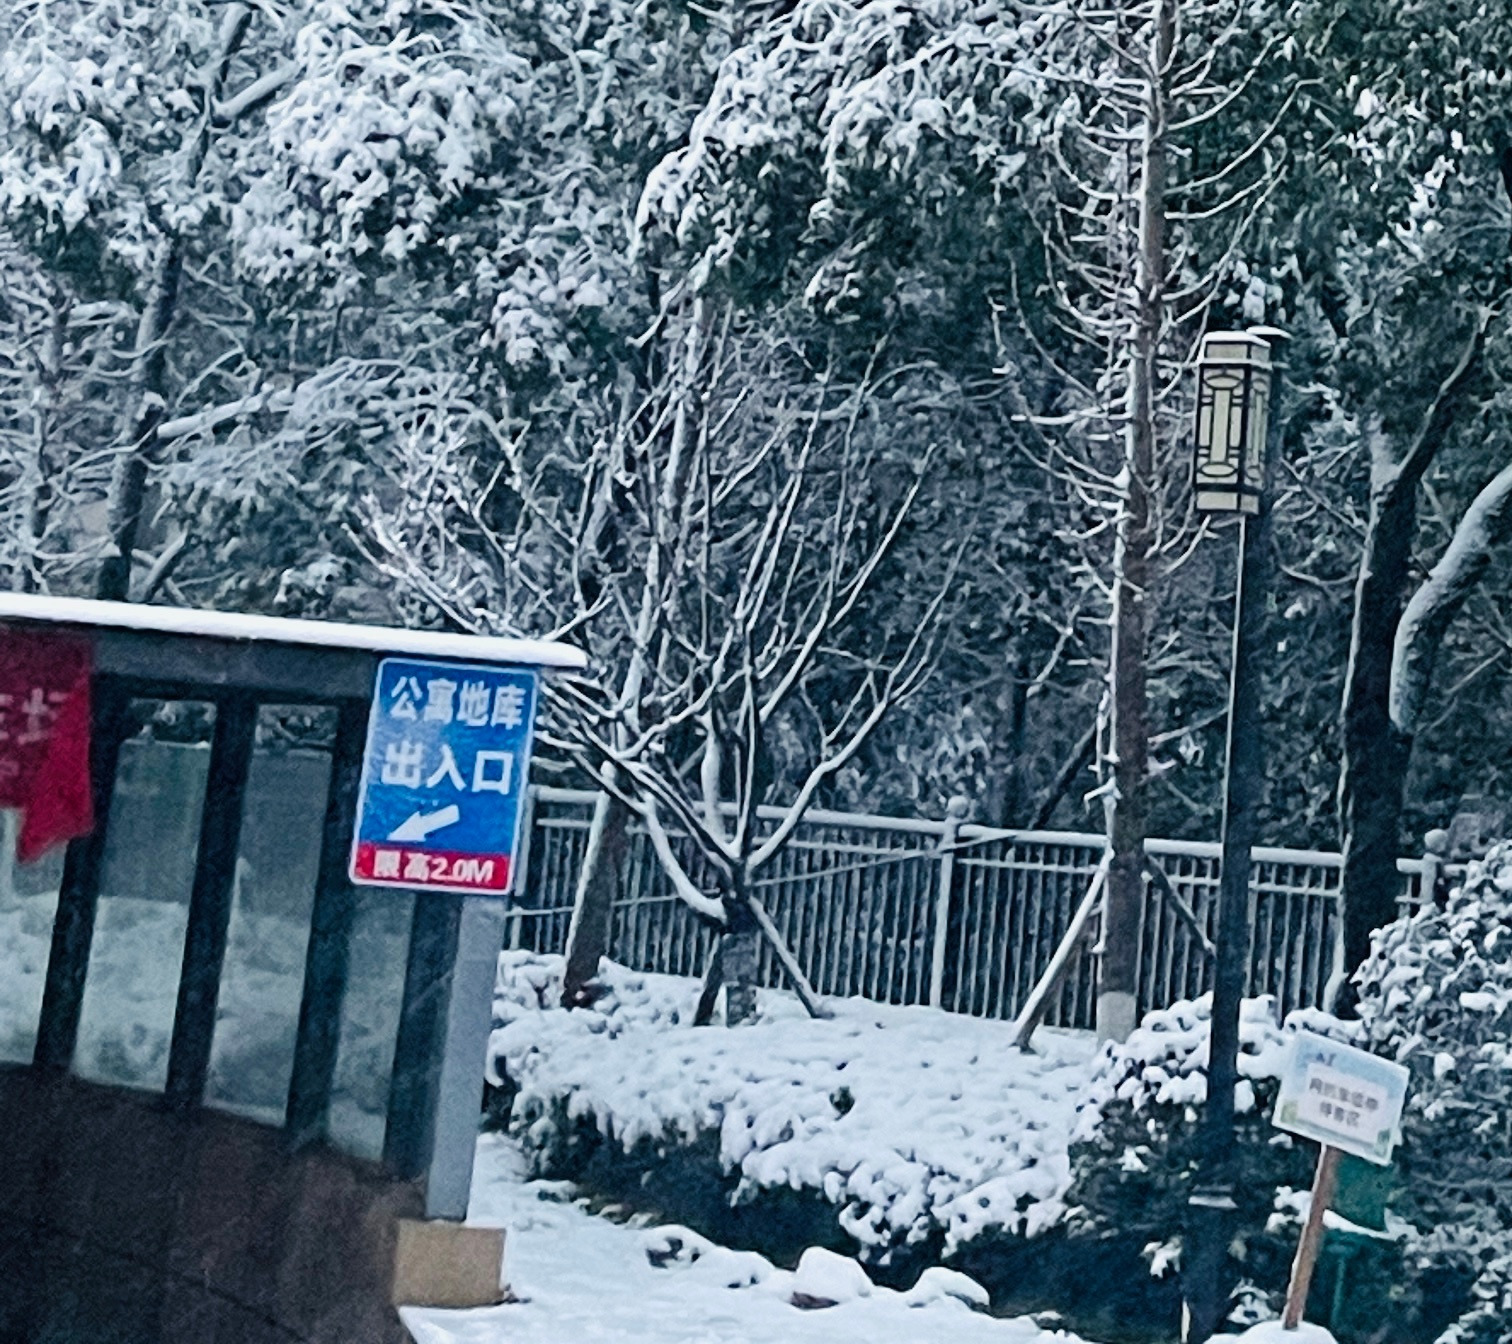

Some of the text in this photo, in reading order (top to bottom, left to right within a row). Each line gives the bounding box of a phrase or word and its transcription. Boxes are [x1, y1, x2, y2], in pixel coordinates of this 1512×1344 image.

[390, 676, 526, 730] 公寓地库
[380, 739, 514, 795] 出入口
